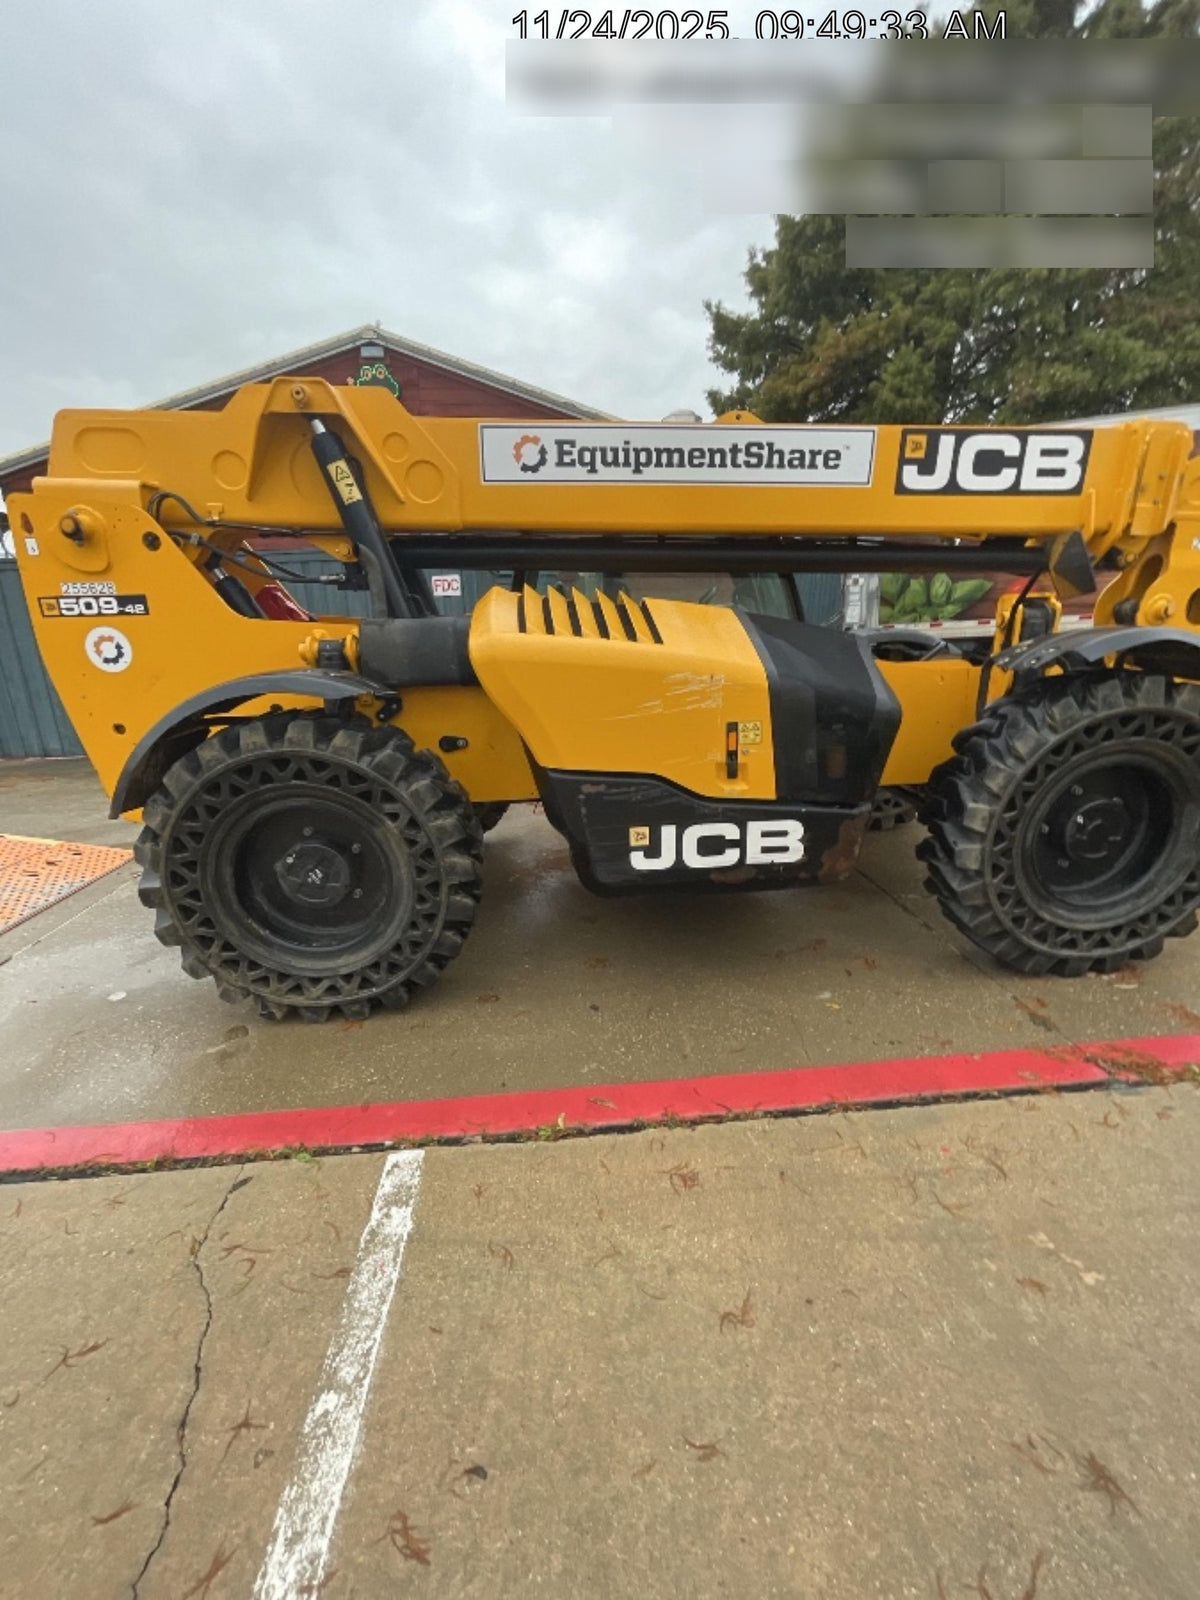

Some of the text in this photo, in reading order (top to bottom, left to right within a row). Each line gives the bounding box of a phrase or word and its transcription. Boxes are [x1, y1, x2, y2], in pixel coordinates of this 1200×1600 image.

[554, 439, 842, 474] EquipmentShare
[902, 434, 1085, 491] JCB
[62, 582, 116, 595] 255628
[433, 579, 459, 592] FDC
[58, 597, 145, 615] 509-42
[629, 819, 805, 870] JCB
